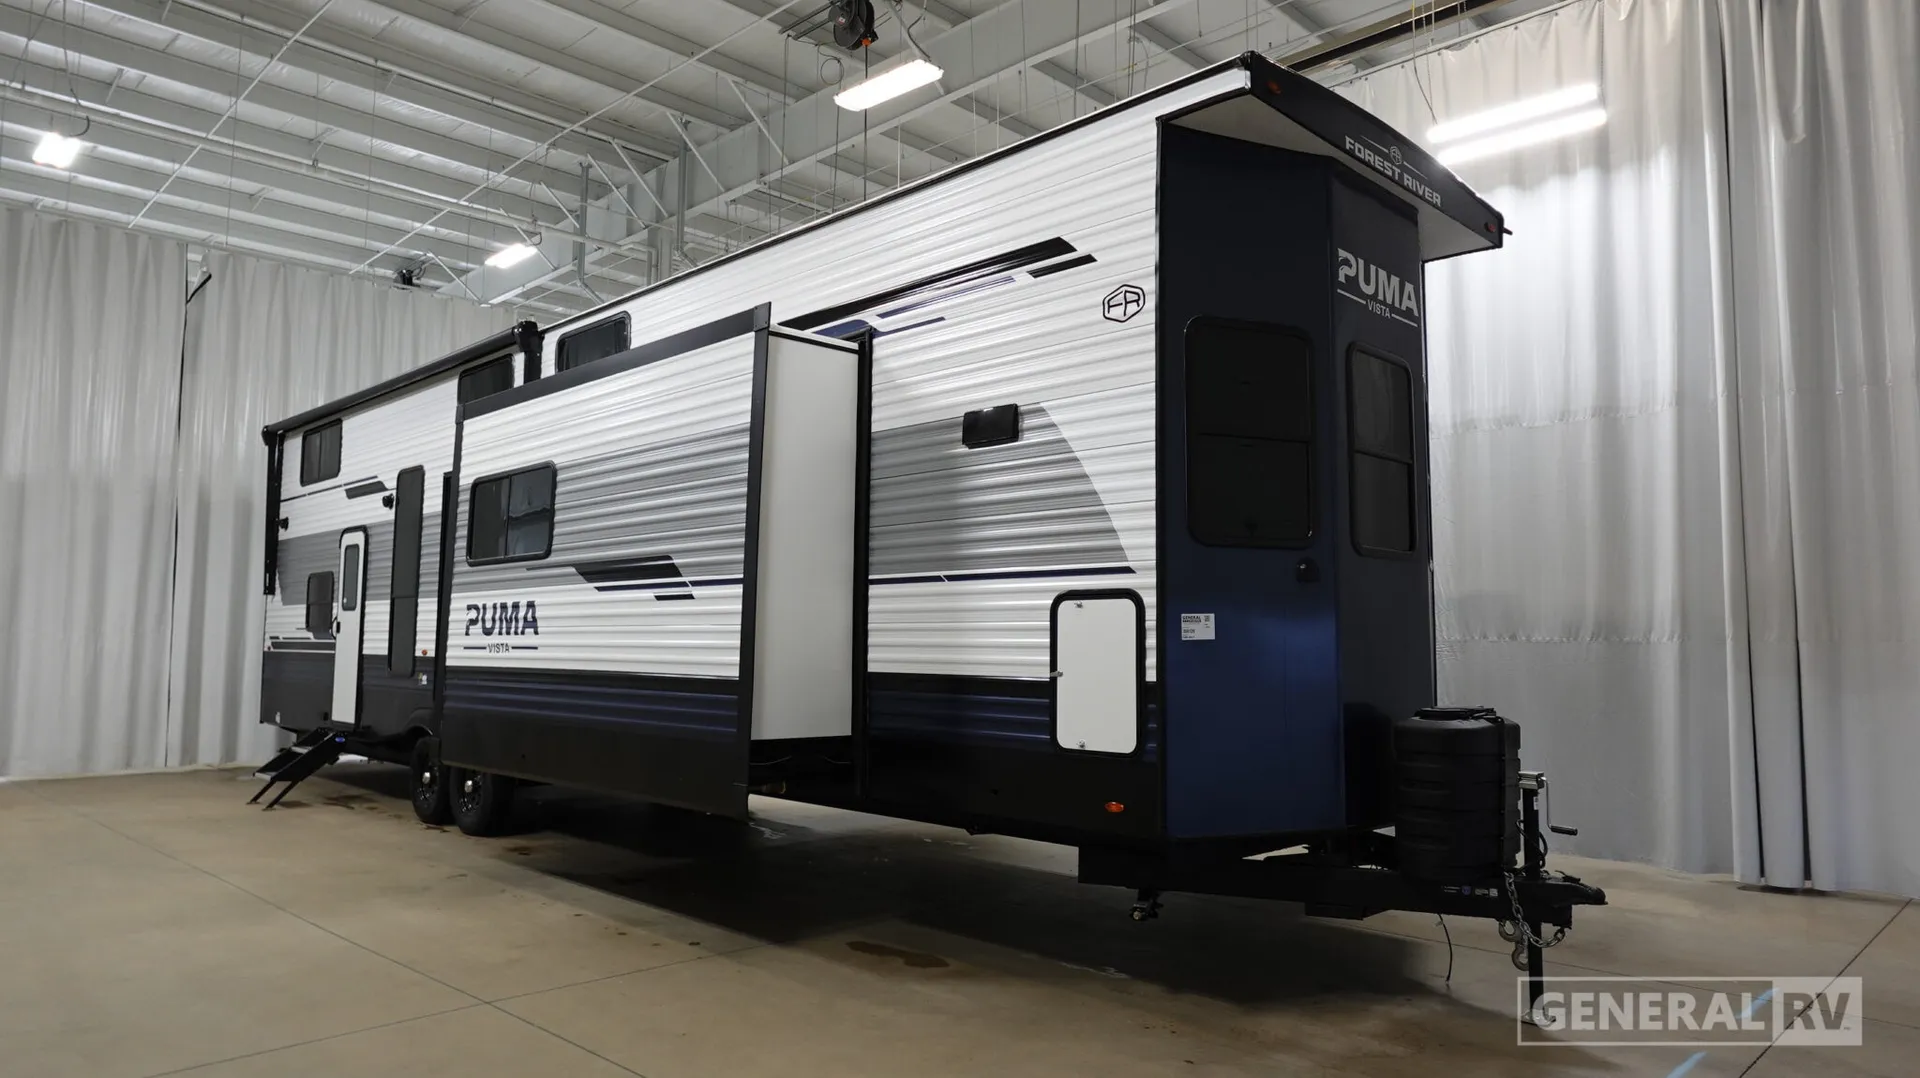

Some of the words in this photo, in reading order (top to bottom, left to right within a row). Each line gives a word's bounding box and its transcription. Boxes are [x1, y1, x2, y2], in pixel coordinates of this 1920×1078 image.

[1345, 135, 1401, 182] FOREST
[1403, 172, 1442, 207] RIVER
[1337, 248, 1419, 317] PUMA
[1367, 299, 1391, 319] VISTA
[465, 600, 539, 636] PUMA
[487, 643, 510, 653] VISTA
